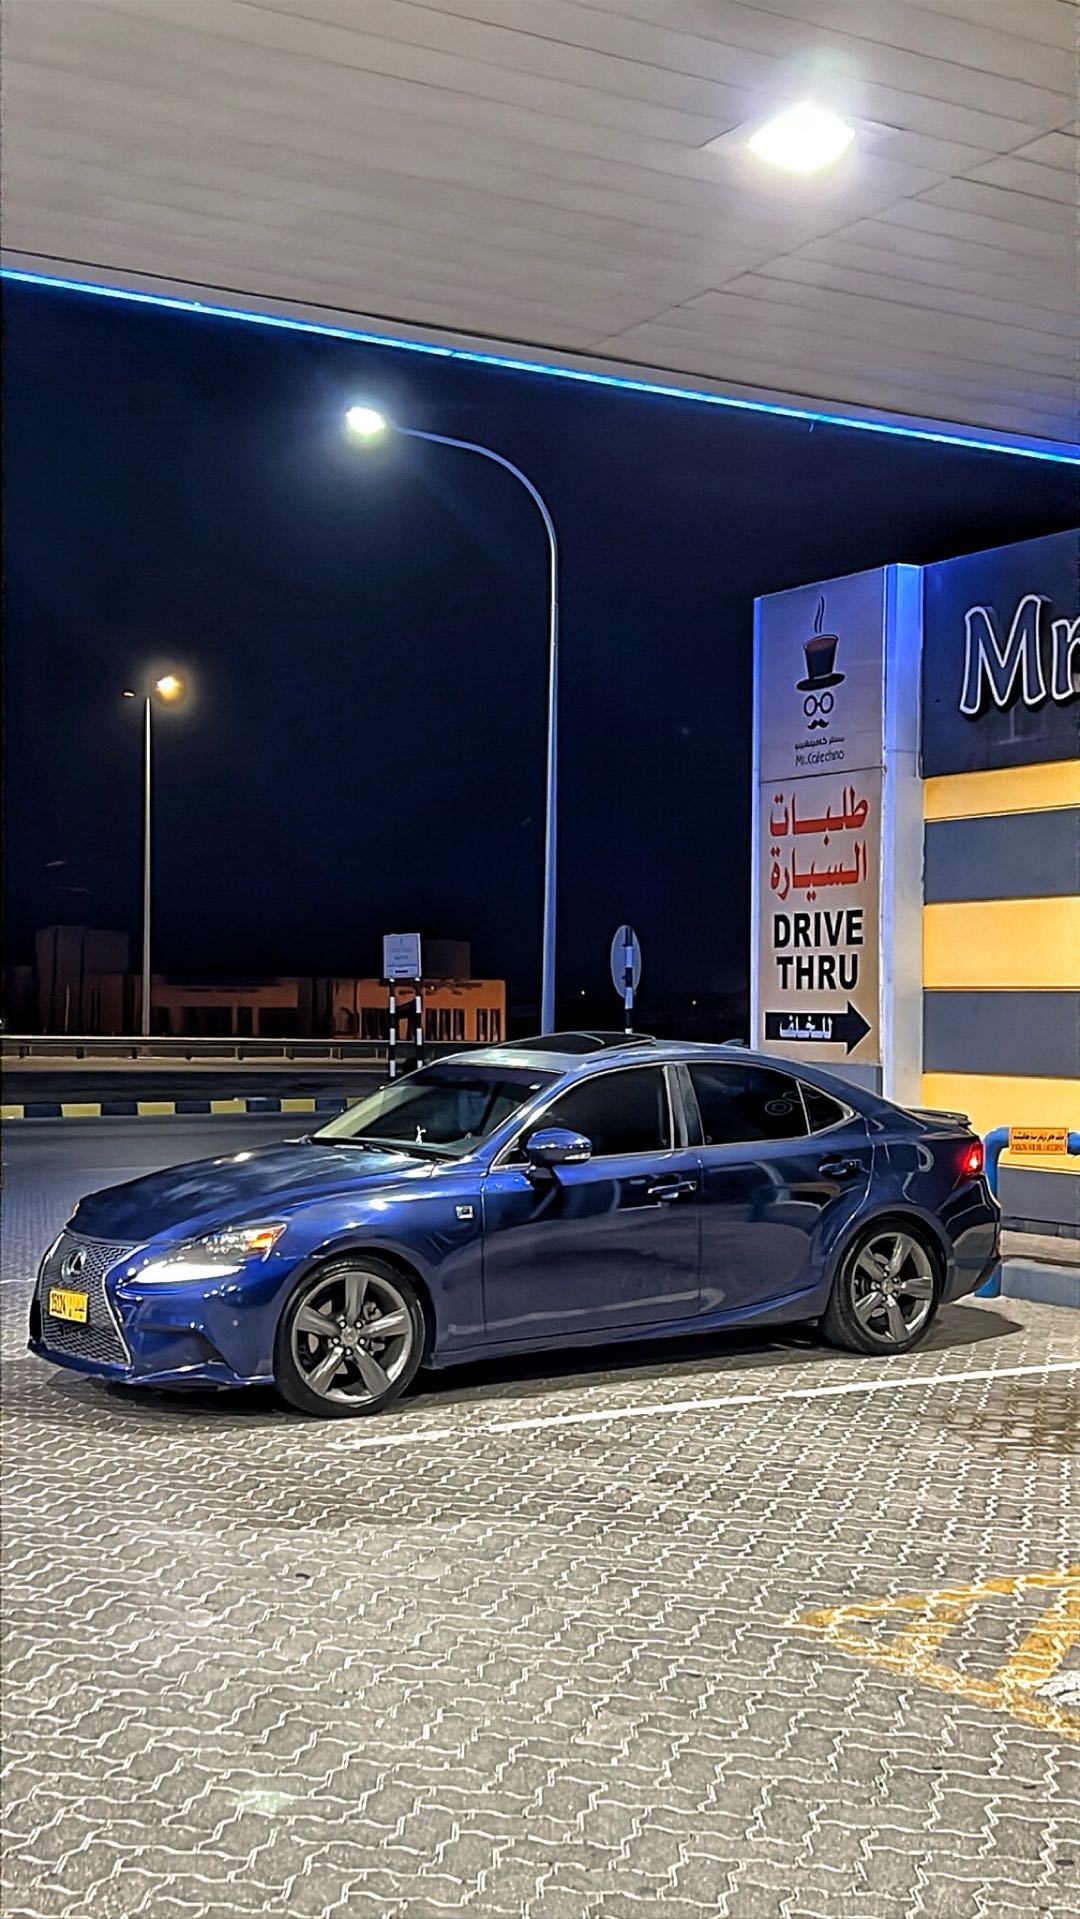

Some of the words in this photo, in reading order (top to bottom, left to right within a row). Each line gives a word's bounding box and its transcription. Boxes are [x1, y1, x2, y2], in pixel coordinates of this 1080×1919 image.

[769, 785, 869, 846] طلبات
[770, 840, 868, 901] السيارة
[773, 909, 864, 949] DRIVE
[776, 953, 859, 991] THRU
